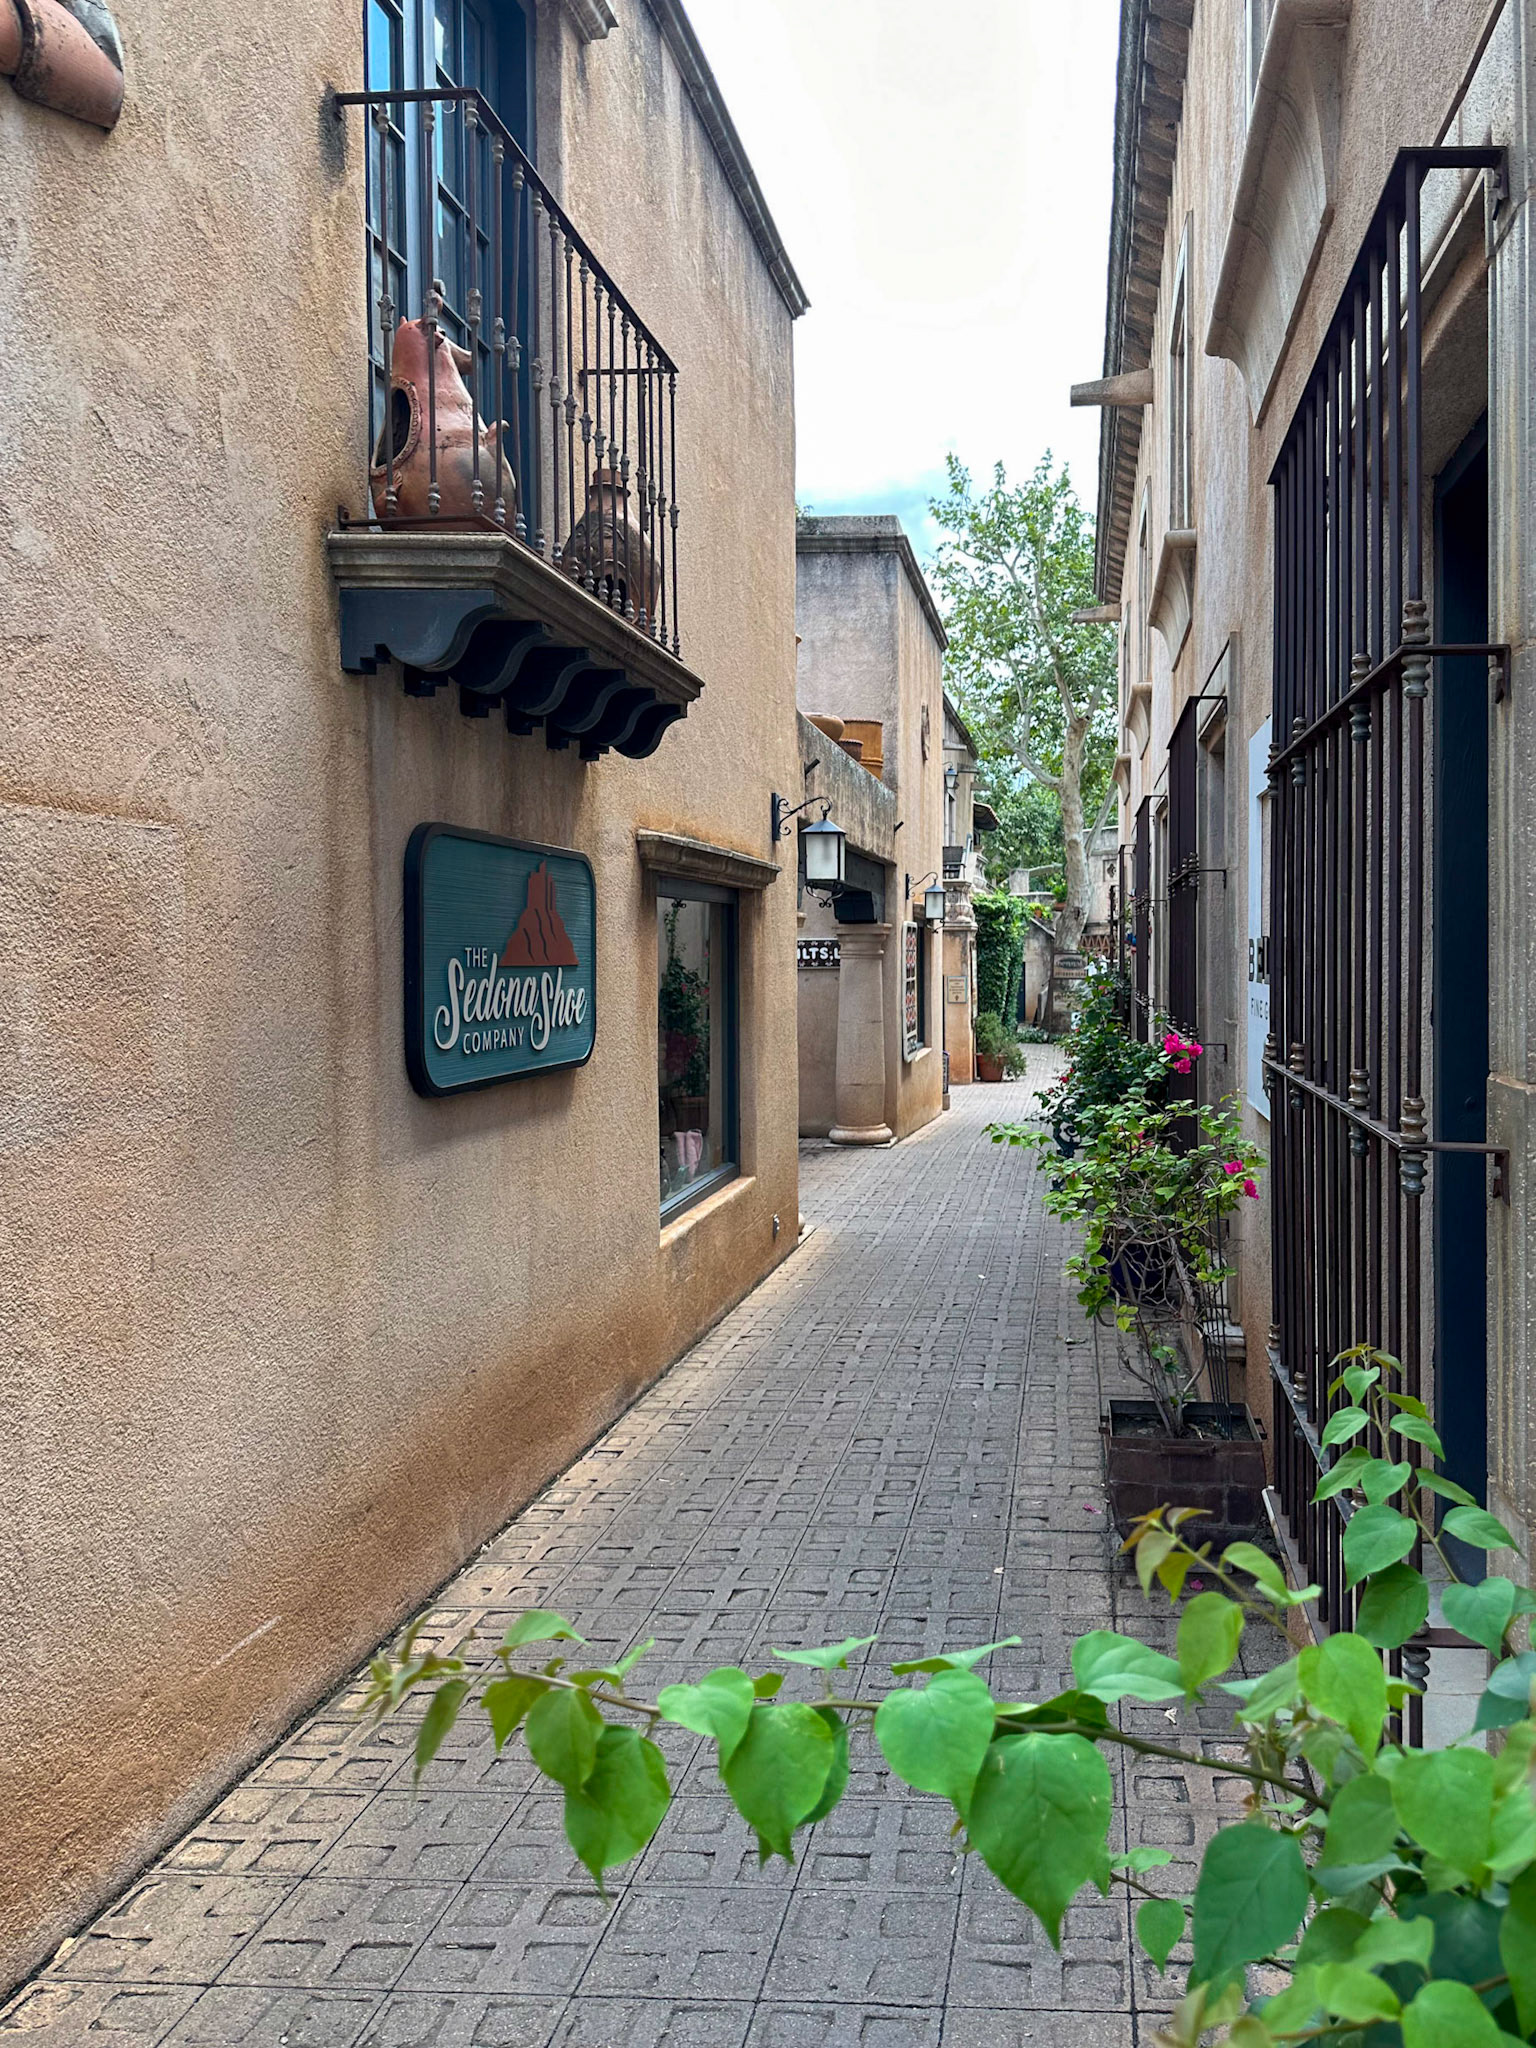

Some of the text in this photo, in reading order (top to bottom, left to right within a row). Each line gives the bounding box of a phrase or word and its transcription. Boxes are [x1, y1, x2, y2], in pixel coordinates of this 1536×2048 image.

[464, 947, 488, 968] THE
[434, 952, 587, 1050] Sedona Shoe
[463, 1027, 525, 1055] COMPANY
